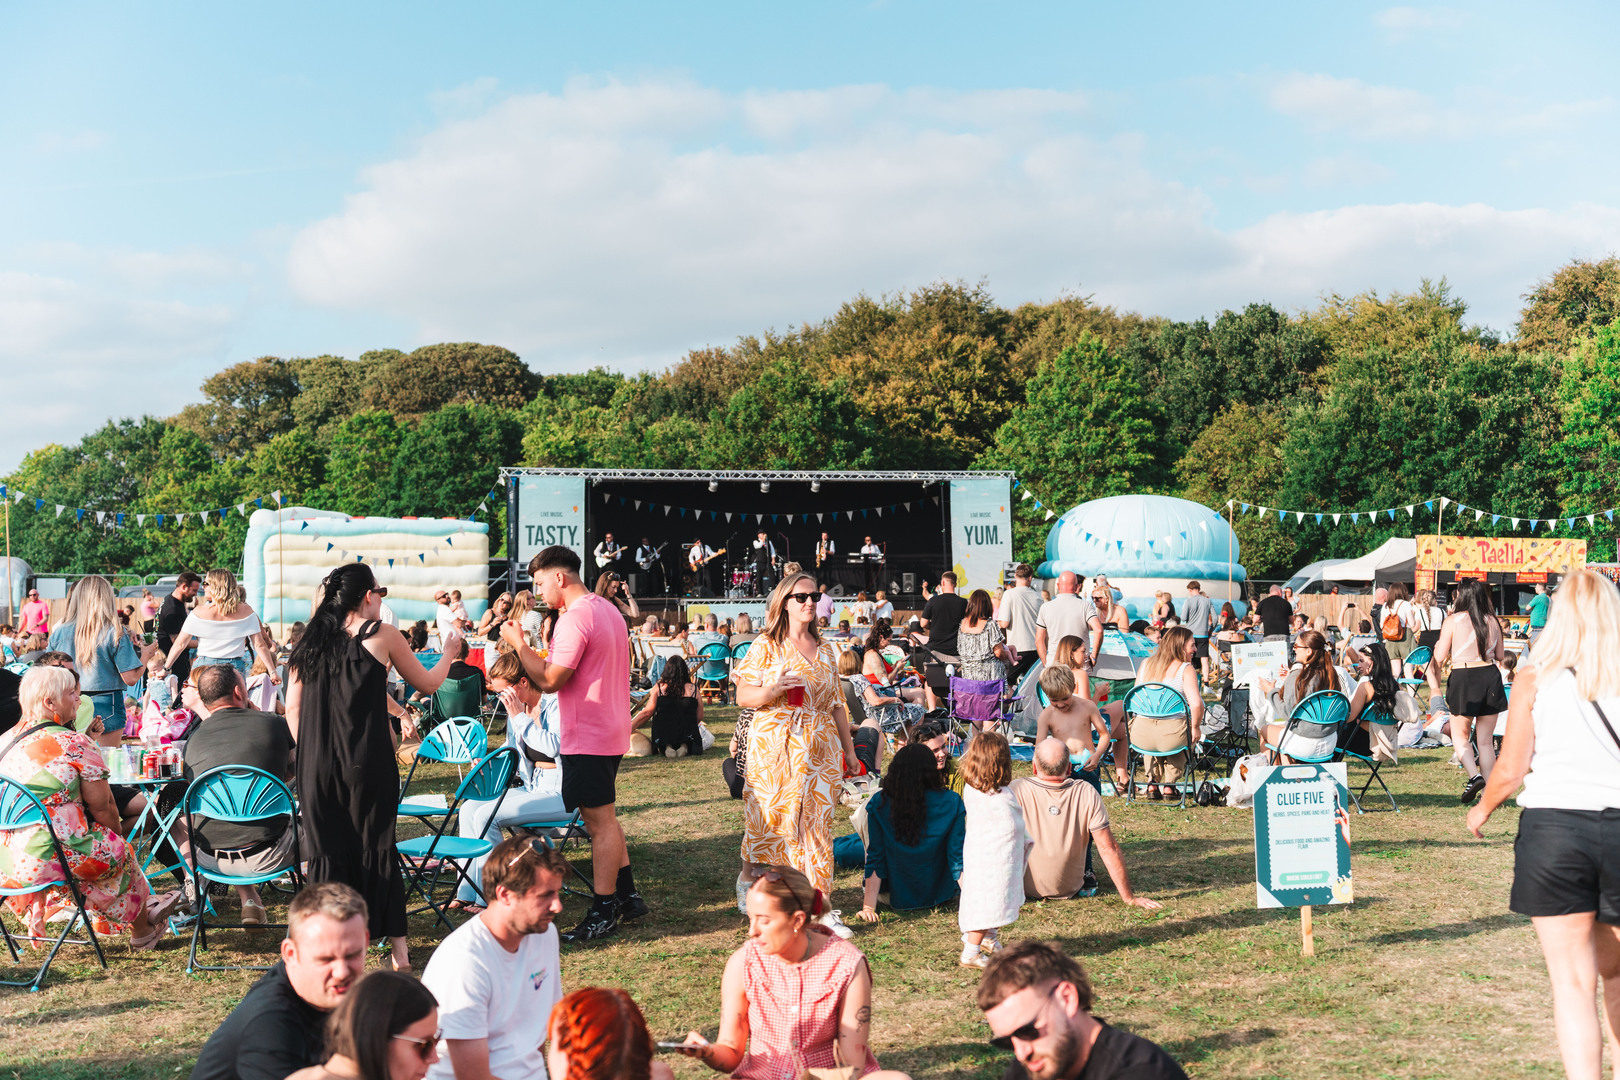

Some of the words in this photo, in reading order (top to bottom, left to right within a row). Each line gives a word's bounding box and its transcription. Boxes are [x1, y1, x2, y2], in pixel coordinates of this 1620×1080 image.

[525, 525, 580, 546] TASTY.
[964, 525, 1003, 545] YUM.
[1476, 541, 1523, 564] Paella
[1277, 792, 1301, 806] CLUE
[1303, 791, 1324, 804] FIVE
